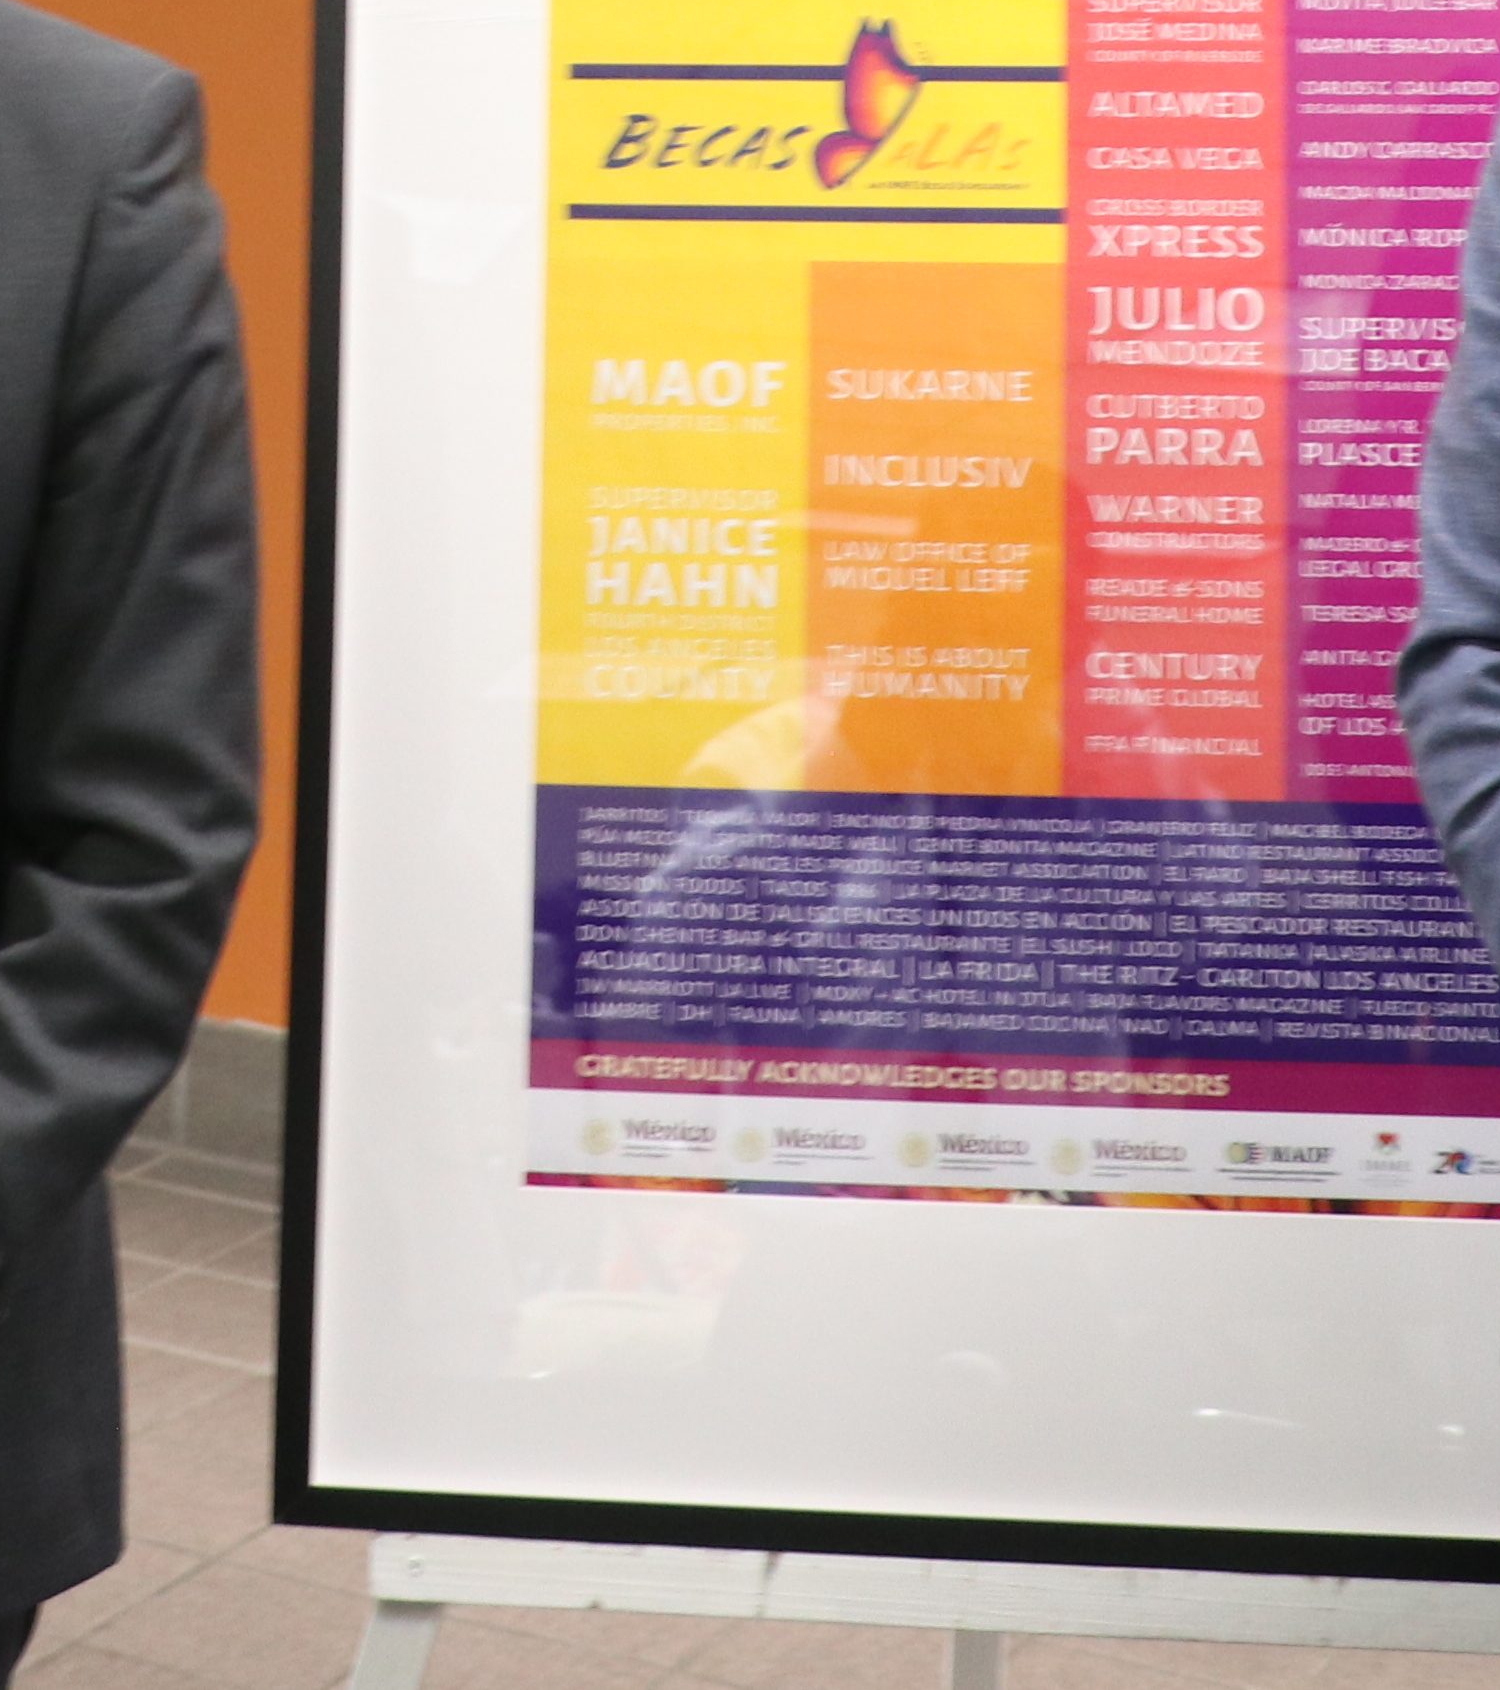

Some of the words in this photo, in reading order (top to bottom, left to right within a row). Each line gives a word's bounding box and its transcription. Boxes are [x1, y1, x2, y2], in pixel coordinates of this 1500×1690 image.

[1086, 91, 1265, 118] ALTAMED
[1086, 146, 1174, 170] CASA
[1087, 225, 1265, 258] XPRESS
[1087, 286, 1265, 335] JULIO
[590, 358, 787, 407] MAOF
[826, 368, 1033, 402] SUKARNE
[1086, 394, 1266, 420] CUTBERTO
[1086, 427, 1264, 466] PARRA
[1298, 442, 1423, 467] PLASCE
[824, 455, 1035, 489] INCLUSIV
[1086, 494, 1264, 525] WARNER
[588, 516, 779, 557] JANICE
[585, 561, 779, 608] HAHN
[1085, 651, 1263, 680] CENTURY
[584, 663, 775, 702] COUNTY
[824, 672, 1030, 701] HUMANITY
[1398, 946, 1490, 965] AIRLINE
[574, 1053, 755, 1084] GRATEFULLY
[756, 1059, 998, 1090] ACKNOWLEDGES
[999, 1066, 1069, 1092] OUR
[1070, 1069, 1230, 1097] SPONSORS
